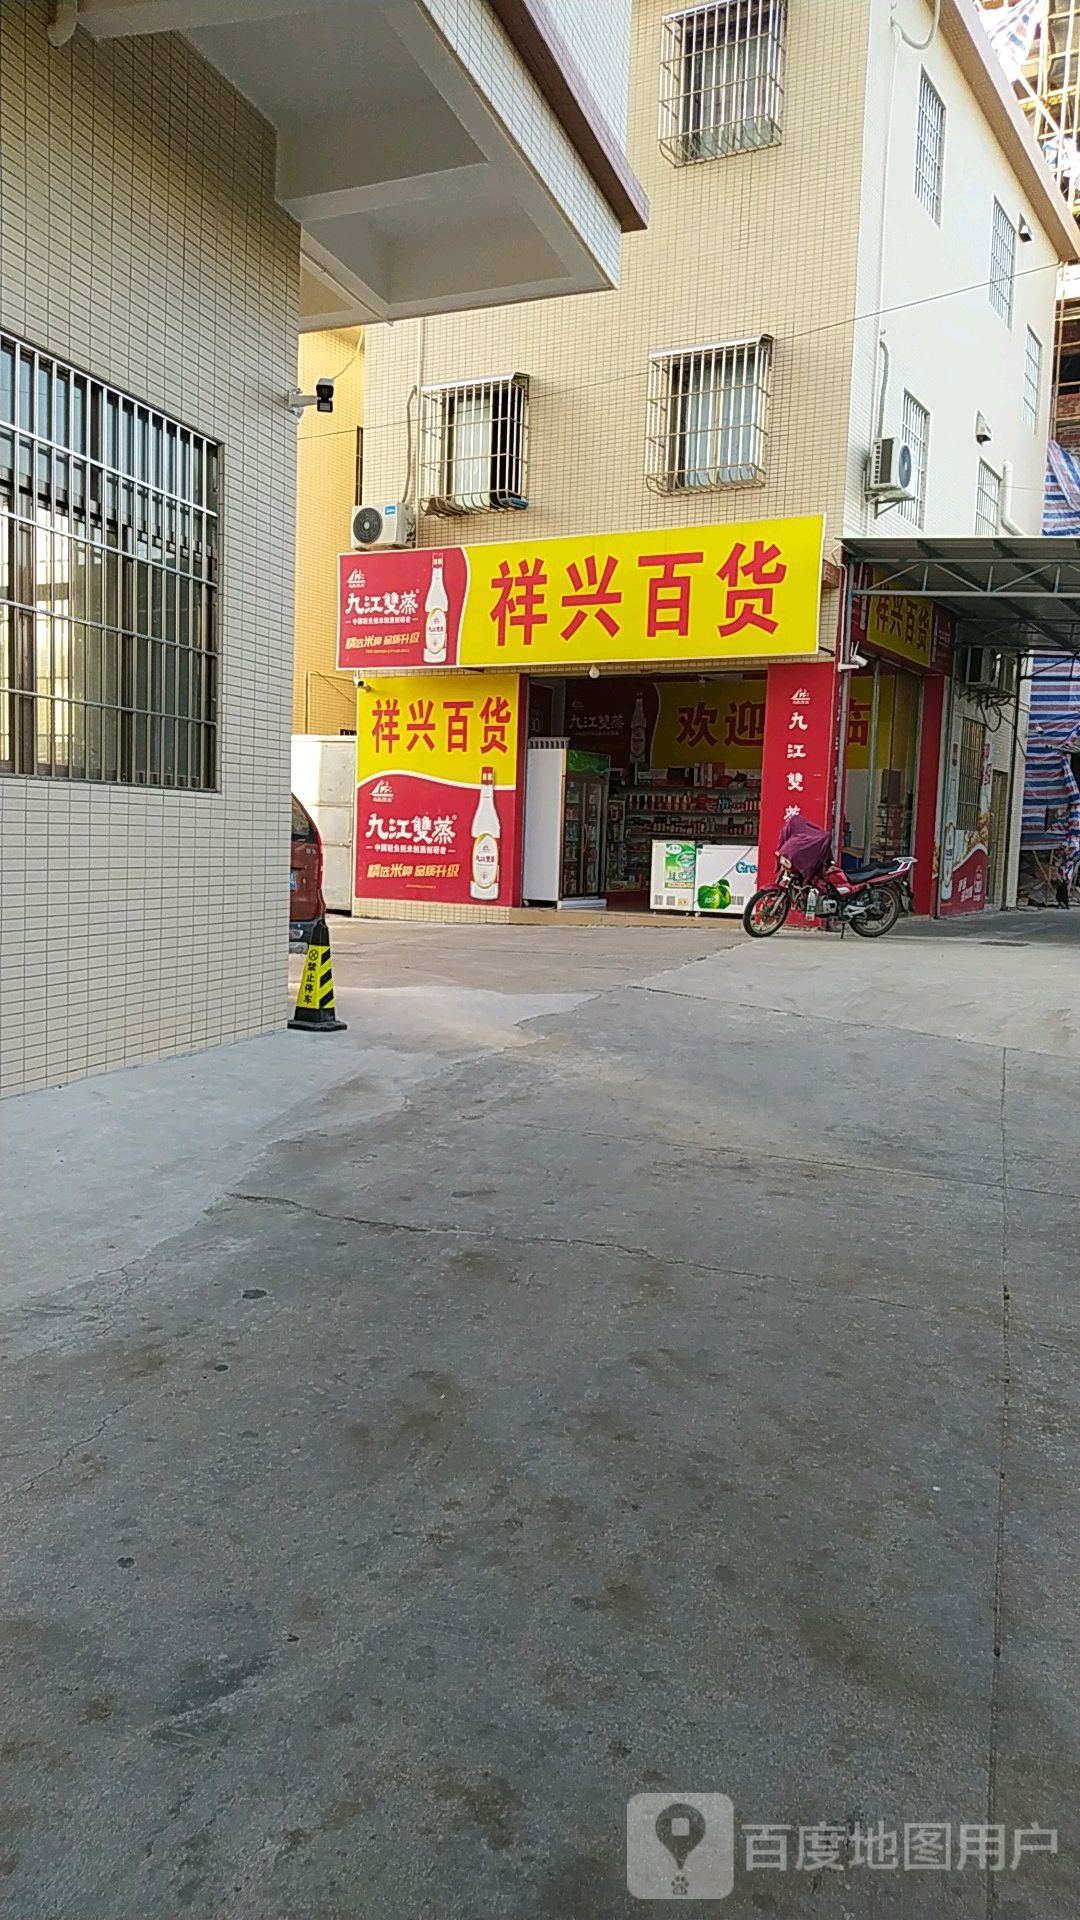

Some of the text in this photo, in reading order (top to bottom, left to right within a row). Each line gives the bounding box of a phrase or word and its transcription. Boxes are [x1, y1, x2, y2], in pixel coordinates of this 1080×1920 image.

[345, 590, 419, 615] 九江雙蒸
[489, 540, 787, 647] 祥兴百货
[371, 696, 511, 754] 祥兴百货
[365, 813, 456, 844] 九江雙蒸
[414, 864, 459, 878] 品质升级
[303, 962, 317, 1004] 禁止停车
